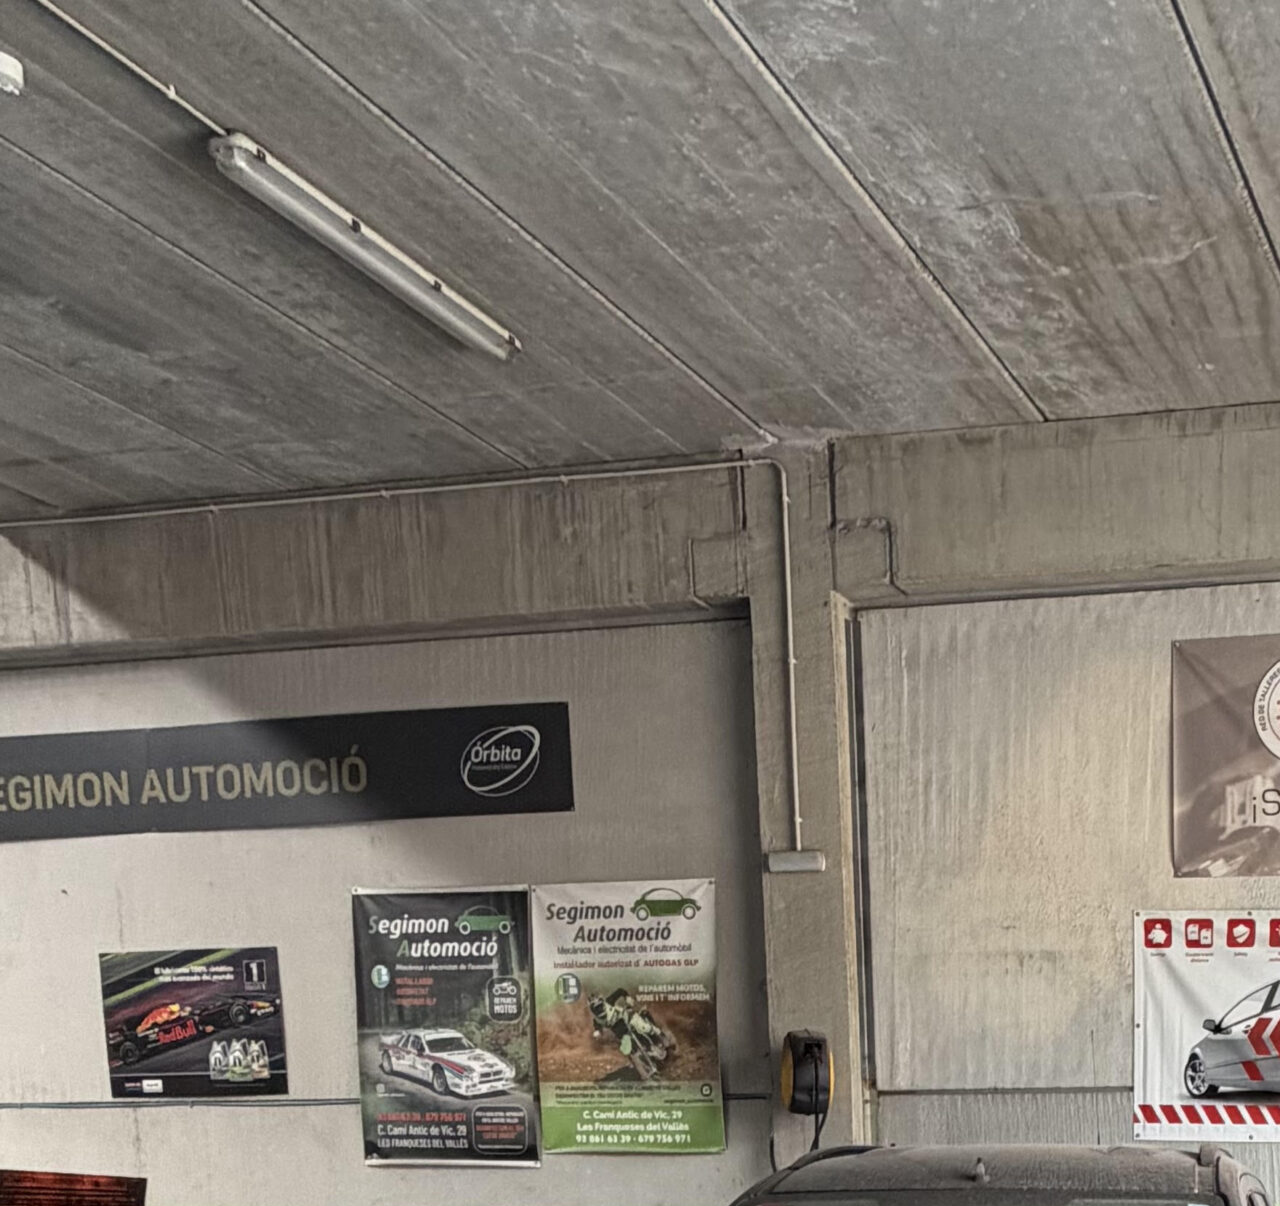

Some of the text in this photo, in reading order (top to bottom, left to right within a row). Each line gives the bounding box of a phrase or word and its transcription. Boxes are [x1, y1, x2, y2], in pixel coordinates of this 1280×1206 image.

[471, 741, 522, 763] Órbita
[0, 744, 368, 812] GIMON AUTOMOCIÓ
[546, 901, 625, 925] Segimon
[368, 914, 450, 939] Segimon
[573, 921, 672, 943] Automoció
[396, 936, 499, 958] Automoció
[638, 944, 648, 953] de
[643, 959, 682, 968] AUTOGAS
[684, 958, 699, 967] GLP
[494, 1005, 517, 1014] MOTOS
[616, 1110, 640, 1119] Antic
[640, 1110, 653, 1119] de
[377, 1125, 386, 1136] C.
[408, 1124, 429, 1136] Antic
[430, 1125, 440, 1135] de
[576, 1122, 593, 1132] Les
[594, 1122, 645, 1133] Franqueses
[646, 1122, 661, 1131] del
[391, 1138, 432, 1149] FRANQUESES
[432, 1138, 444, 1148] DEL
[674, 1134, 691, 1143] 971
